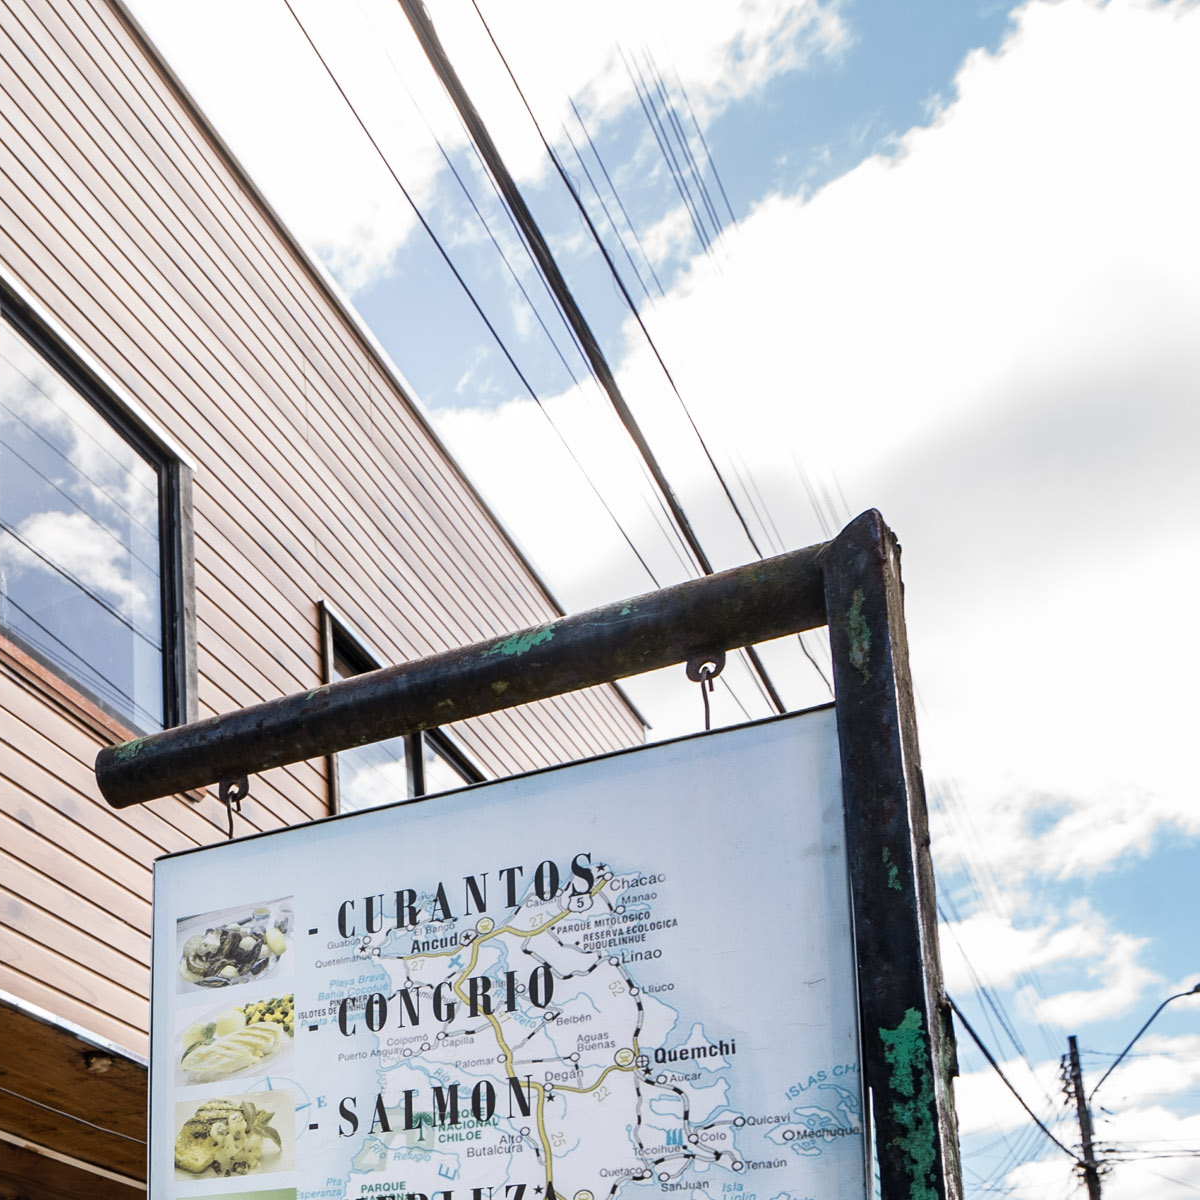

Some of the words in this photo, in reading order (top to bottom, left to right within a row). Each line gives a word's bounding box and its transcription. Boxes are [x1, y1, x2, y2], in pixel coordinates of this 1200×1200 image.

[610, 873, 667, 892] Chacao
[337, 852, 595, 938] CURANTOS
[621, 892, 657, 906] Manao
[529, 912, 544, 928] 27
[556, 921, 592, 935] PARQUE
[594, 911, 651, 928] MITOLOGICO
[583, 928, 624, 943] RESERVA
[626, 918, 679, 935] ECOLOGICA
[411, 933, 459, 954] Ancud
[583, 933, 647, 951] PUQUELINHUE
[621, 948, 662, 964] Linao
[411, 960, 425, 972] 27
[608, 979, 626, 998] 52
[338, 965, 554, 1037] CONGRIO
[556, 1013, 592, 1027] Belbén
[442, 1037, 475, 1049] Capilla
[577, 1032, 610, 1044] Aguas
[577, 1040, 617, 1052] Buenas
[654, 1039, 737, 1064] Quemchi
[338, 1051, 368, 1063] Puerto
[455, 1057, 495, 1070] Palomar
[544, 1068, 584, 1082] Degán
[670, 1072, 703, 1085] Aucar
[785, 1069, 828, 1101] ISLAS
[593, 1086, 612, 1103] 22
[316, 1095, 328, 1109] E
[338, 1073, 533, 1138] SALMON
[438, 1130, 482, 1144] CHILOE
[499, 1134, 523, 1145] Alto
[700, 1132, 727, 1143] Colo
[797, 1125, 860, 1140] Mechuque
[466, 1143, 523, 1158] Butalcura
[633, 1144, 681, 1157] Tocoihue
[746, 1157, 788, 1172] Tenaún
[600, 1167, 643, 1178] Quetaco
[361, 1181, 407, 1194] PARQUE
[722, 1182, 744, 1192] Isla
